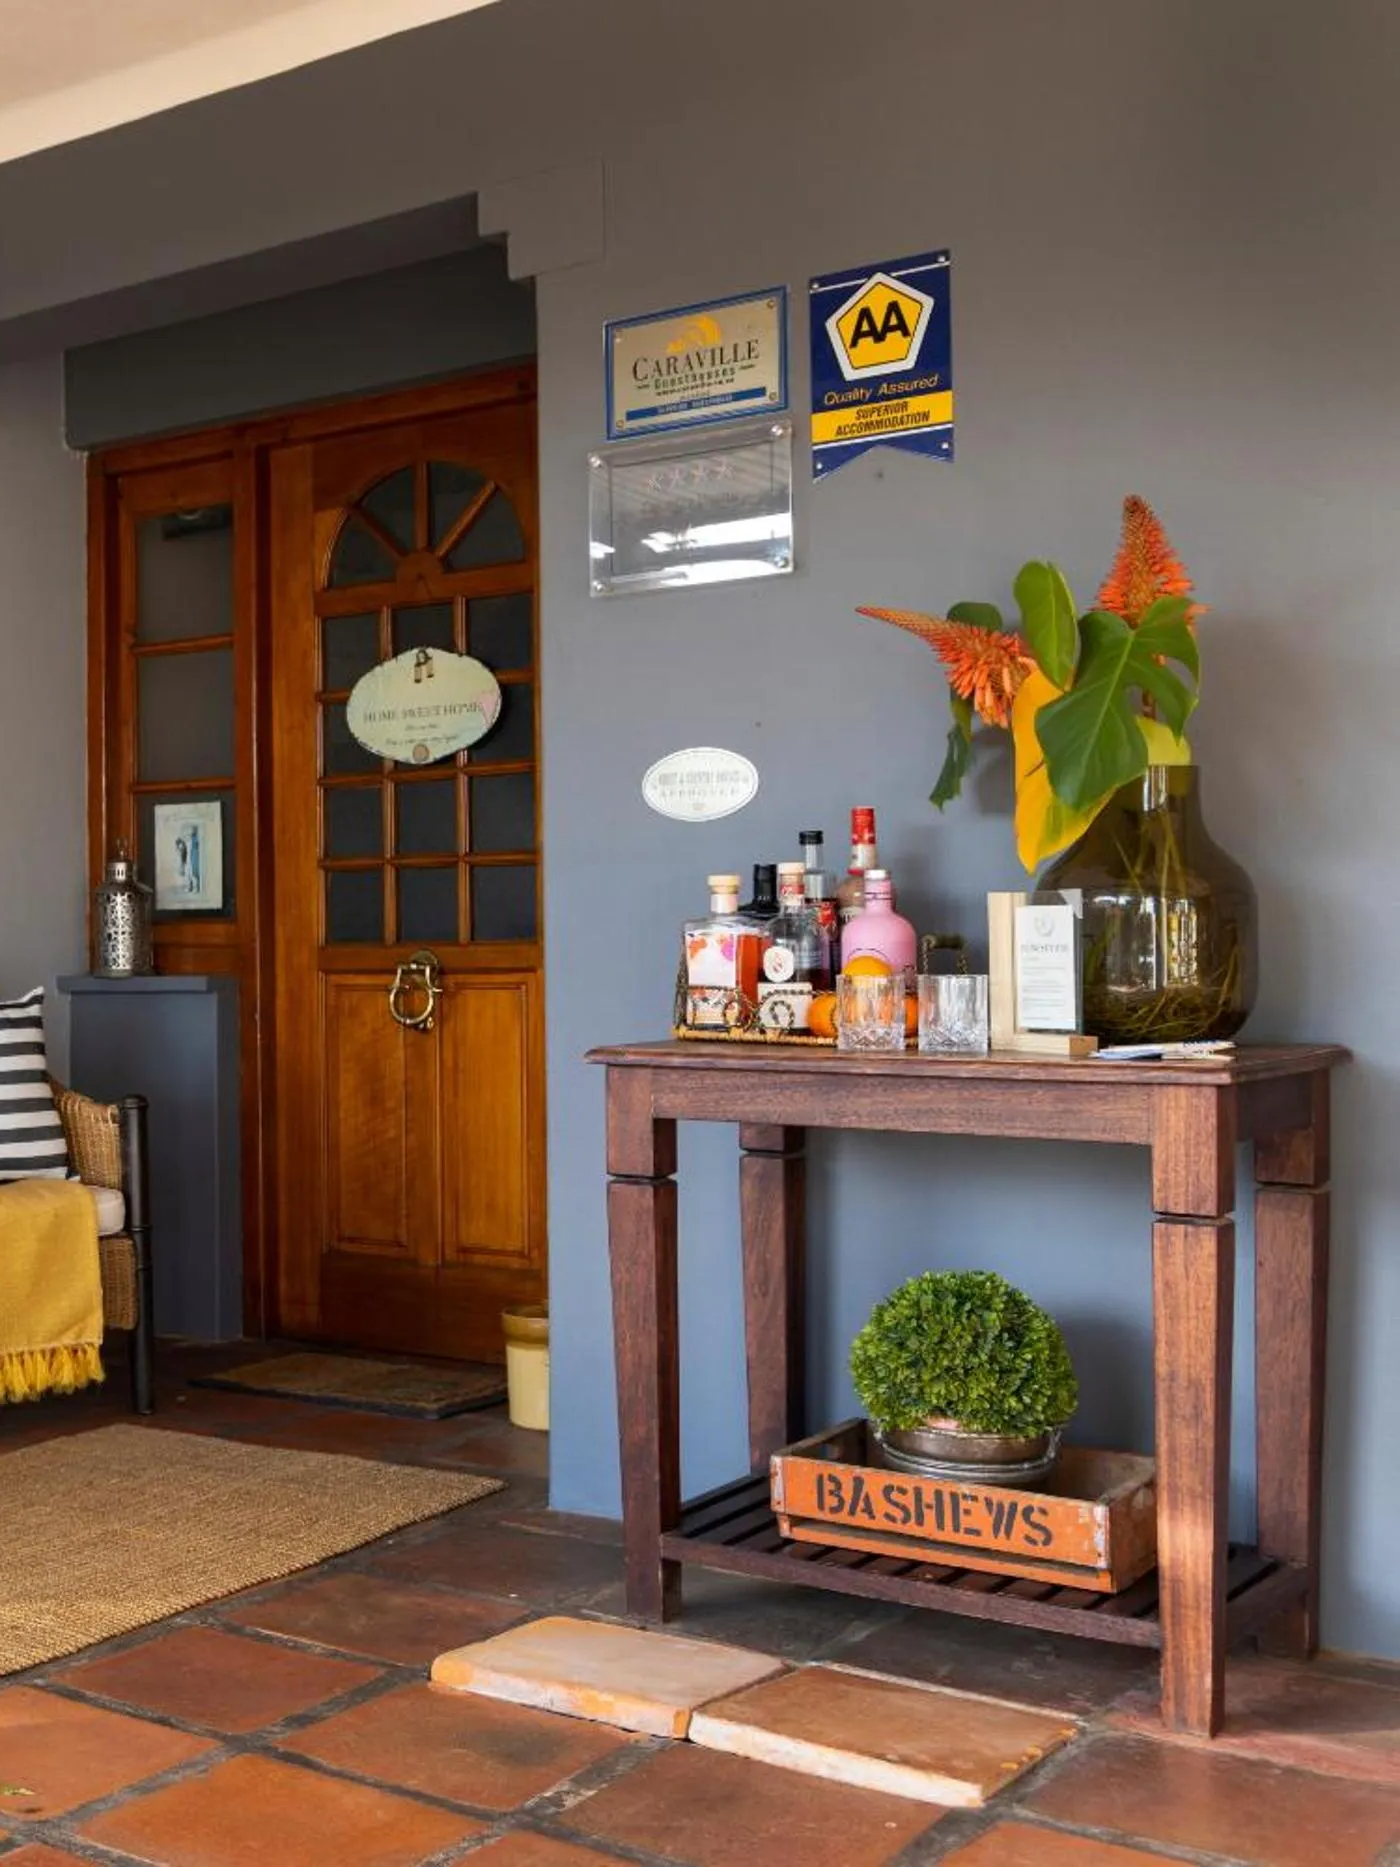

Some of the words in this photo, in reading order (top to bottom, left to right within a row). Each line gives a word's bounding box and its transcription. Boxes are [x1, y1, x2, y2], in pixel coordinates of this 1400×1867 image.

[849, 300, 912, 349] AA
[632, 339, 760, 382] CARAVILLE
[823, 387, 873, 406] Quality
[877, 374, 940, 396] Assured
[836, 410, 931, 437] ACCOMMODATION
[855, 400, 910, 421] SUPERIOR
[816, 1472, 1053, 1548] BASHEWS
